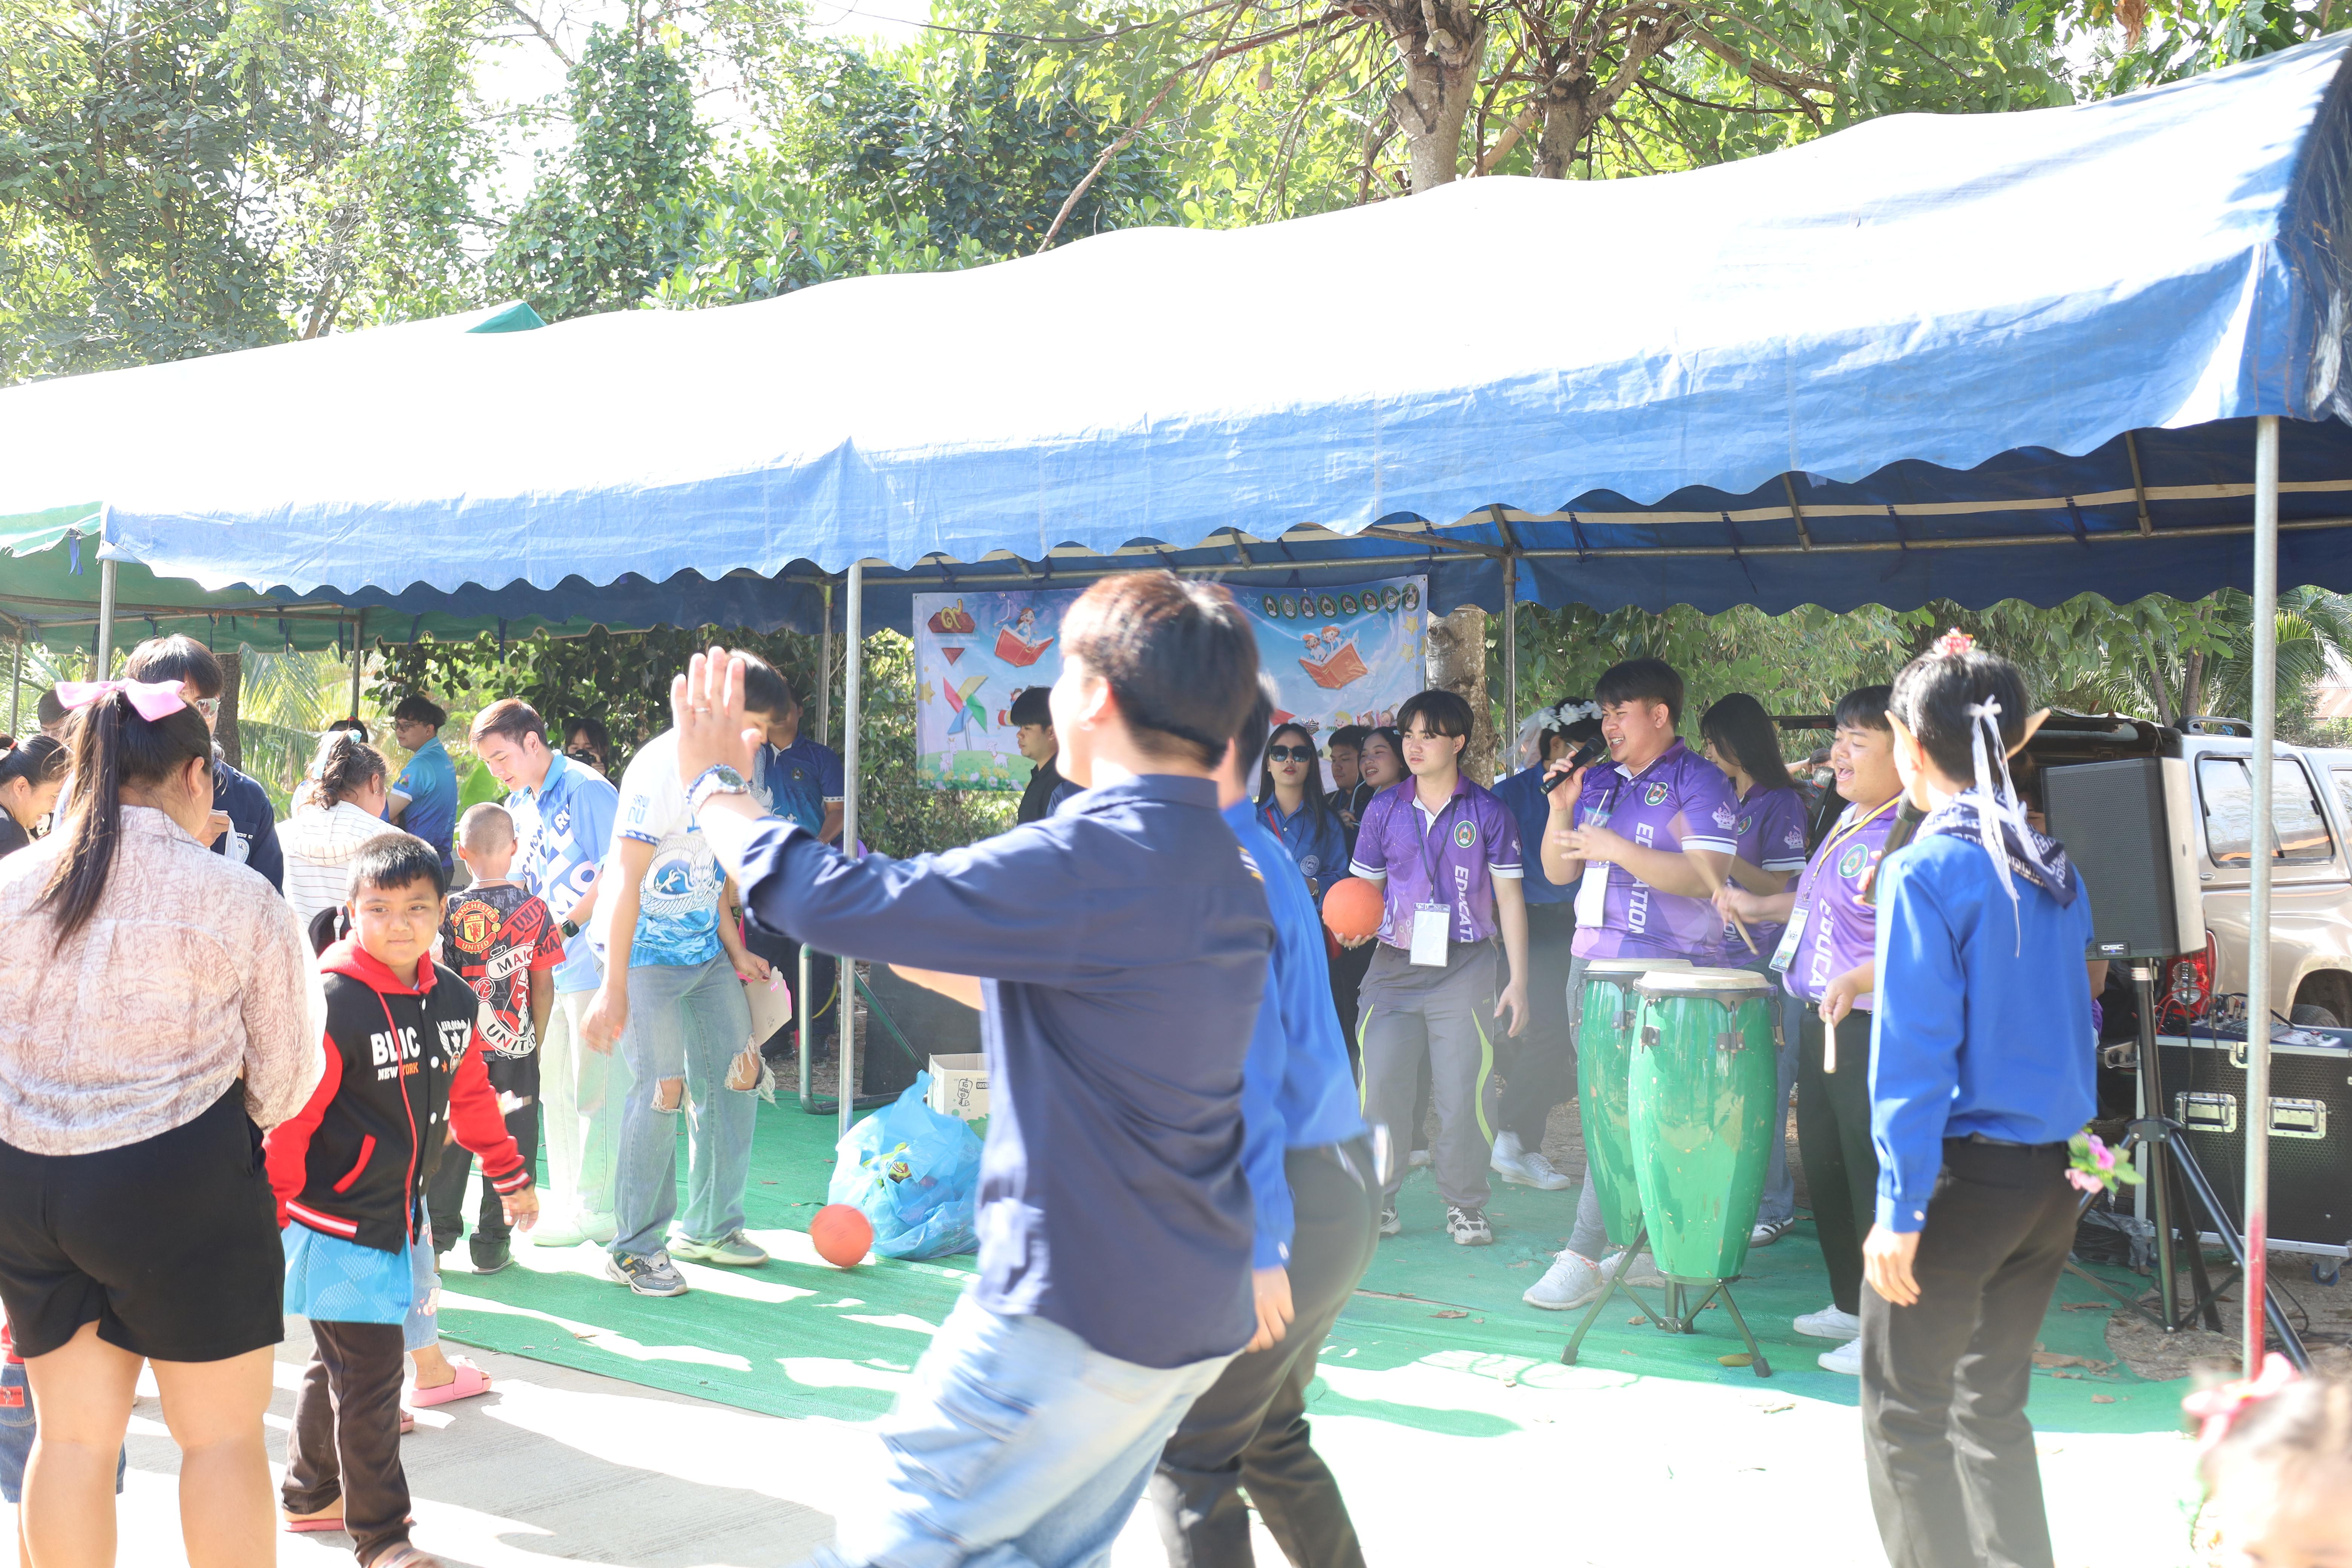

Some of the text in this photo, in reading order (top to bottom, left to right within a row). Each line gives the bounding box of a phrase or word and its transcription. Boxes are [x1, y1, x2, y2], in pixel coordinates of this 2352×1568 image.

[455, 903, 496, 923] MANCHESTER
[462, 940, 489, 950] UNITED
[378, 1066, 398, 1081] NEW
